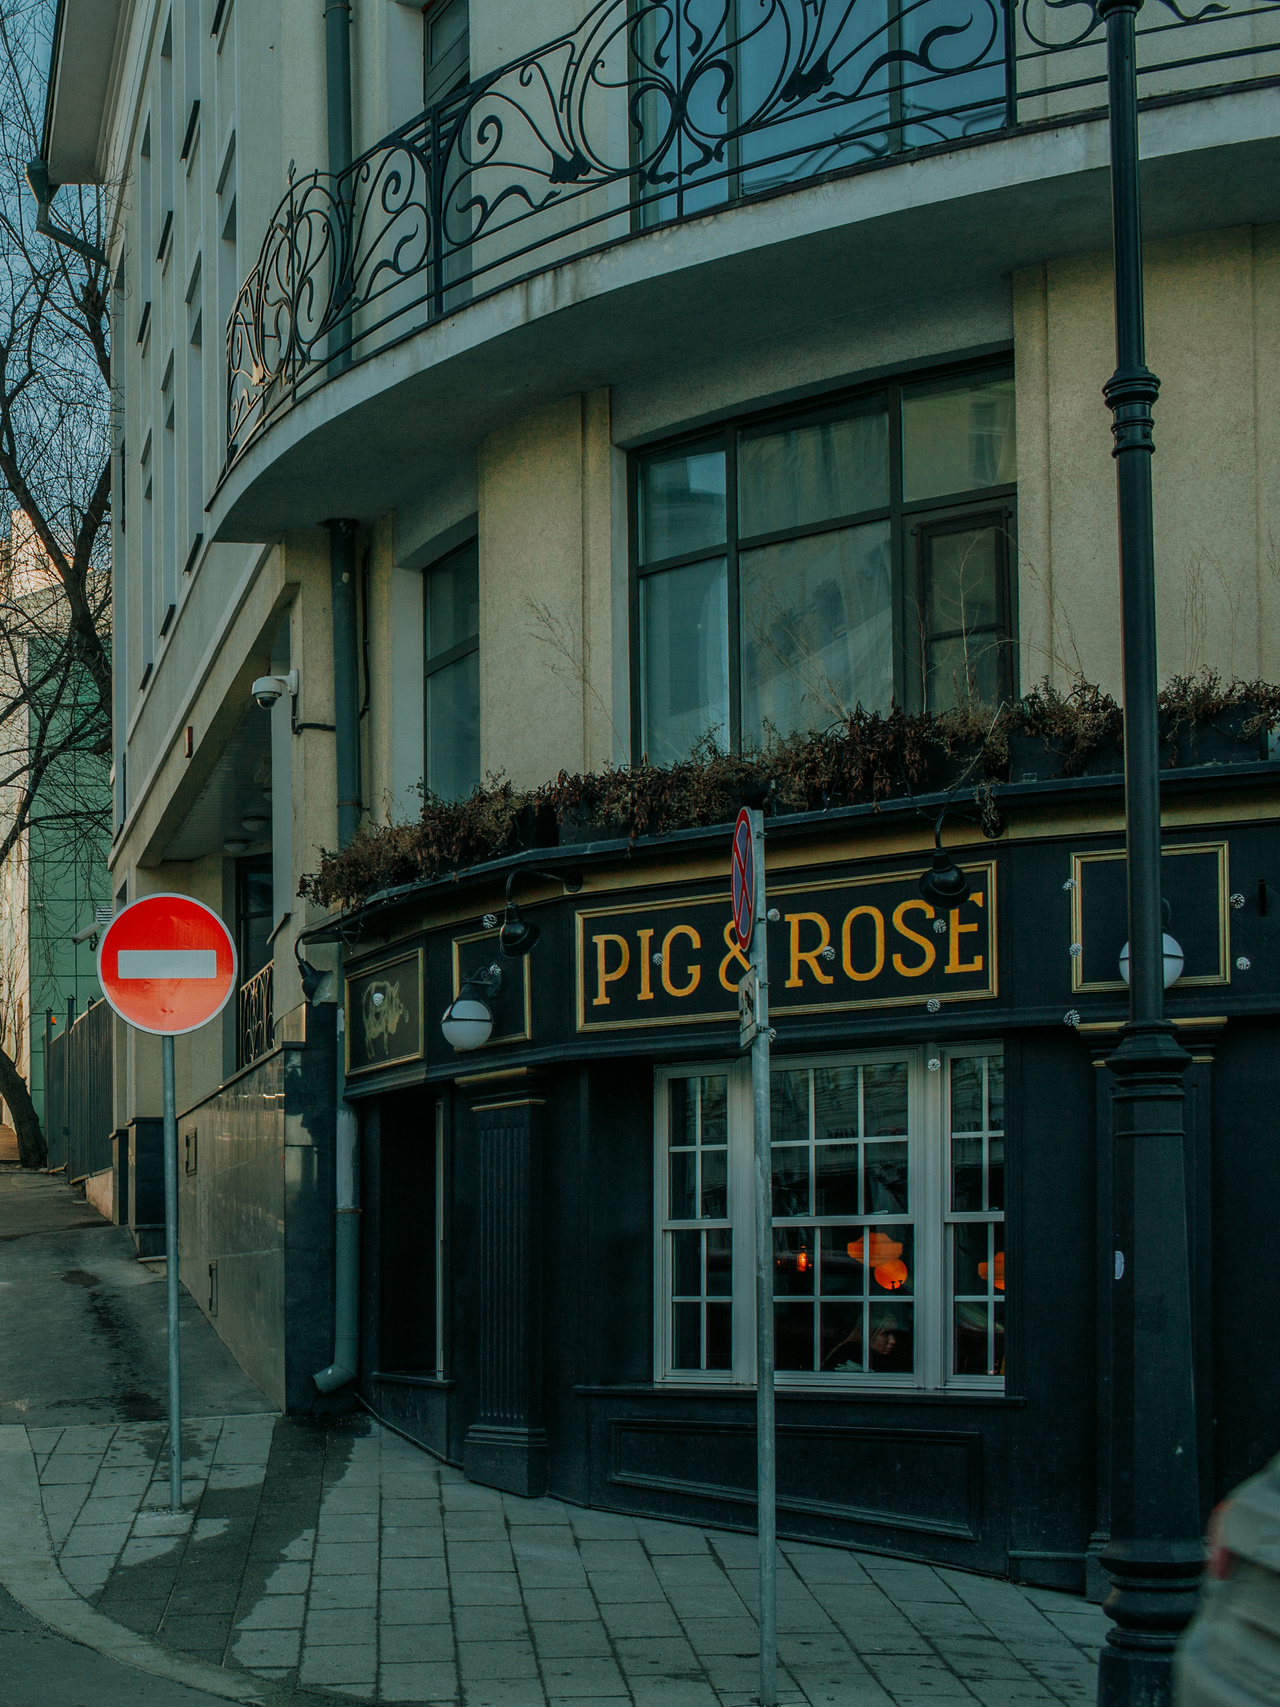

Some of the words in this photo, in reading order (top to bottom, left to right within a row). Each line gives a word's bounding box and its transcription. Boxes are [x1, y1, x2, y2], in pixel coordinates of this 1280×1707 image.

[592, 924, 701, 1005] PIG
[719, 920, 752, 992] &
[784, 892, 983, 988] ROSE
